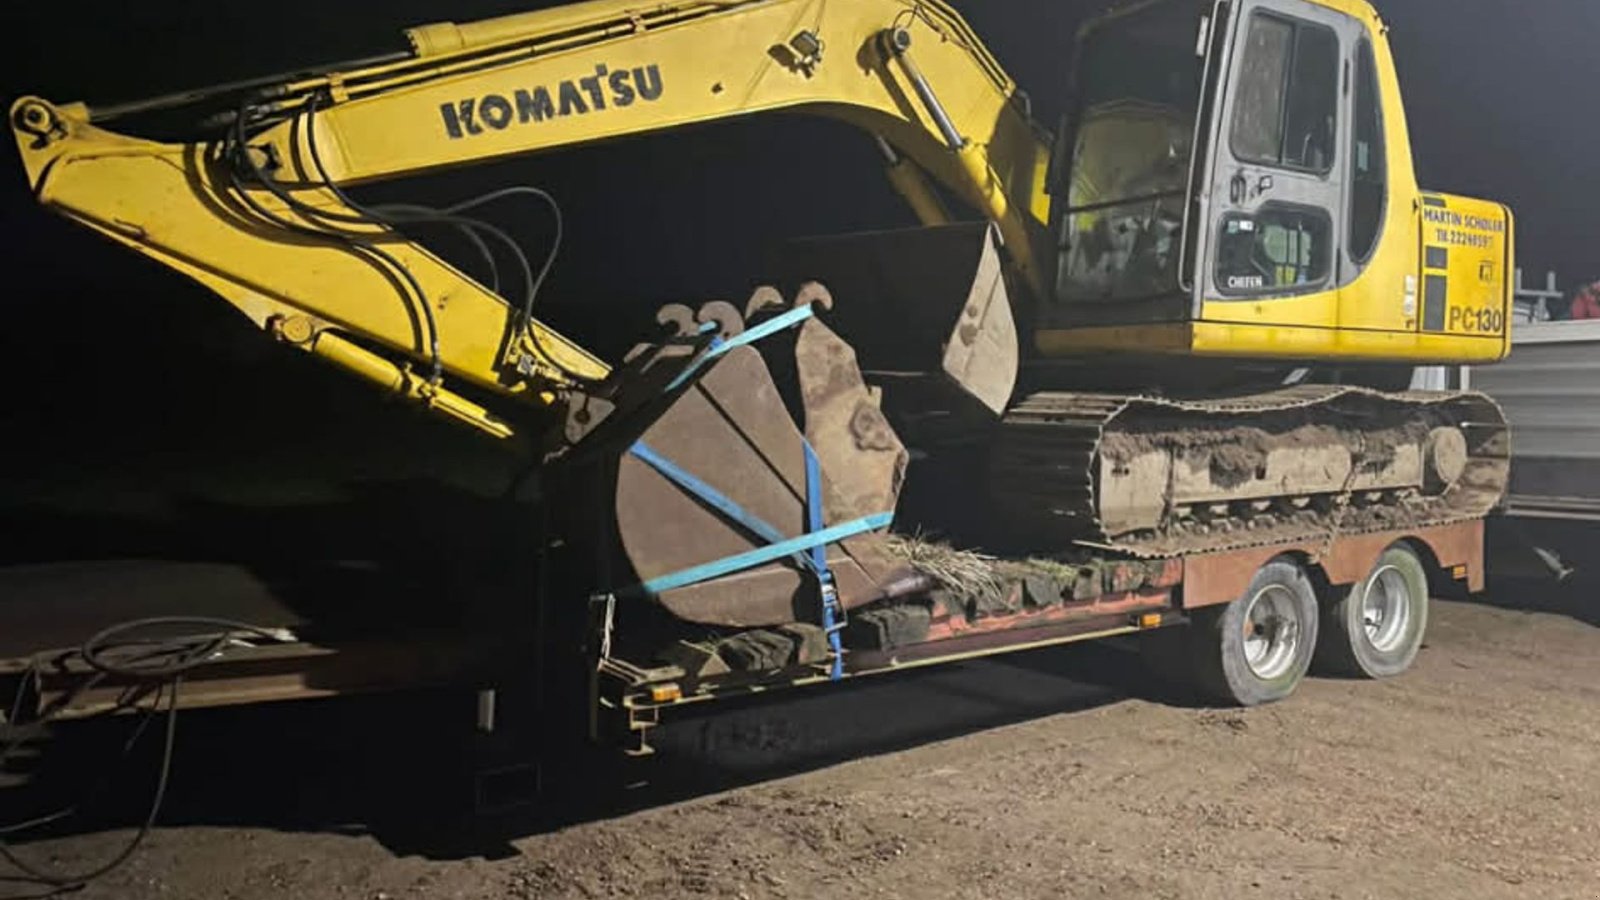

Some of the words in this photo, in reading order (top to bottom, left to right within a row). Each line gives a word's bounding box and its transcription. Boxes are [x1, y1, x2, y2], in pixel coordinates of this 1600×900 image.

[440, 63, 663, 139] KOMATSU
[1423, 208, 1462, 227] MARTIN
[1449, 305, 1501, 332] PC130
